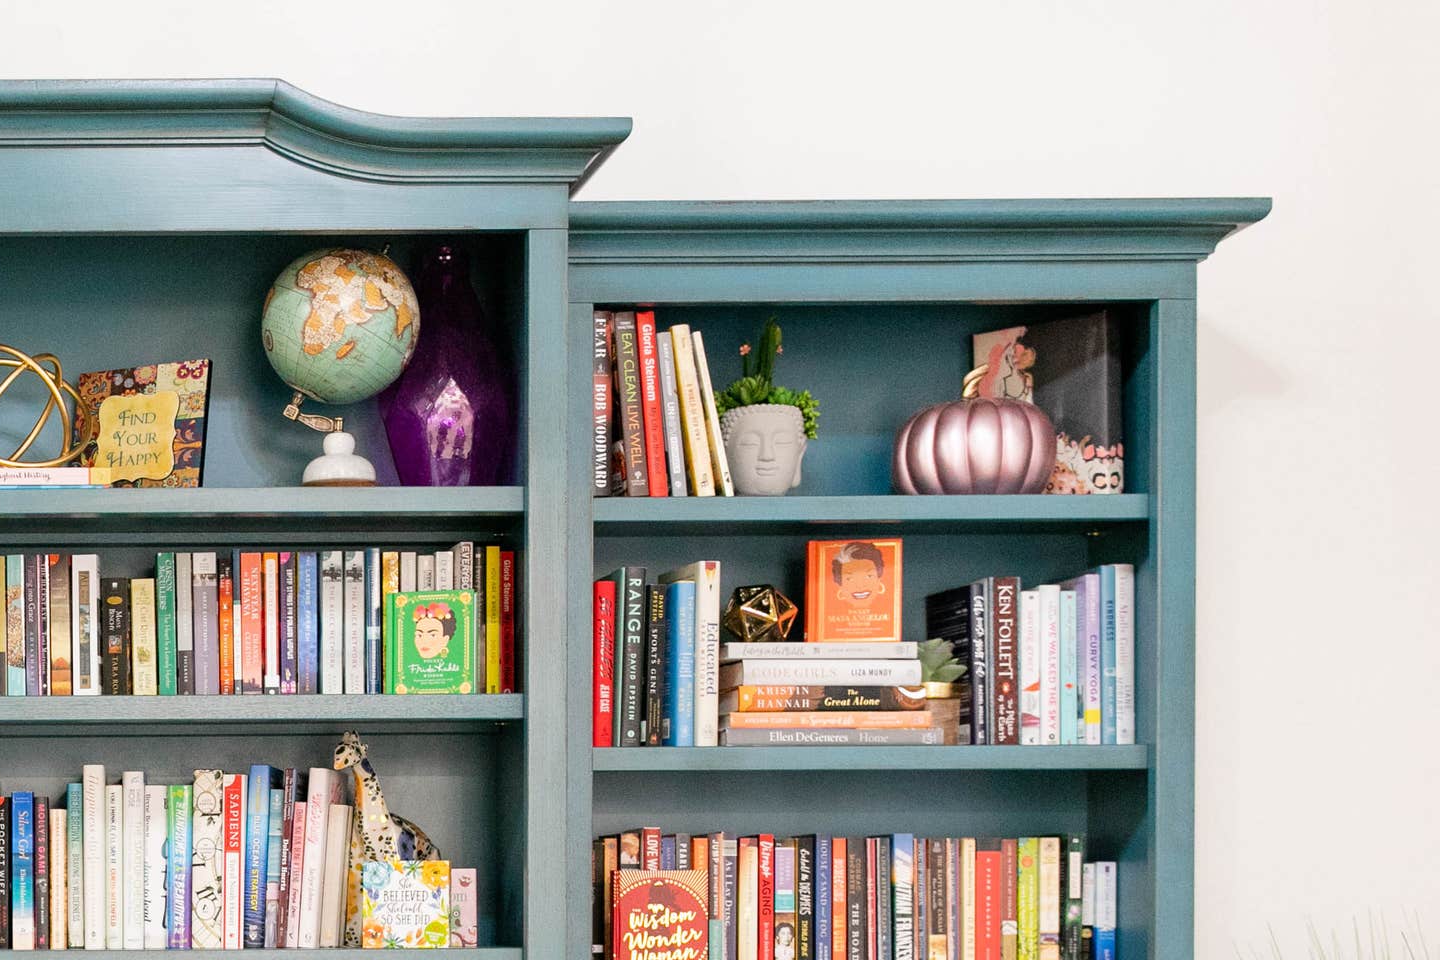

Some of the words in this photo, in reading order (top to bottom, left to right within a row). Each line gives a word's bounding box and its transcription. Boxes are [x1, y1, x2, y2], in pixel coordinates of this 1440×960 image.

[595, 318, 607, 358] FEAR
[621, 332, 634, 355] EAT
[641, 323, 653, 355] Gloria
[623, 360, 637, 402] CLEAN
[644, 358, 656, 401] Steinem
[595, 383, 607, 411] BOB
[118, 409, 157, 427] FIND
[627, 405, 640, 429] LIVE
[112, 430, 159, 447] YOUR
[595, 415, 607, 489] WOODWARD
[628, 431, 642, 468] WELL
[105, 451, 161, 469] HAPPY
[23, 471, 51, 482] History
[503, 559, 511, 581] Gloria
[503, 582, 511, 613] Steinem
[627, 578, 642, 644] RANGE
[997, 585, 1013, 615] KEN
[649, 628, 658, 665] SPORTS
[706, 623, 718, 695] Educated
[998, 619, 1013, 680] FOLLETT
[1088, 634, 1097, 668] CURVY
[628, 653, 637, 680] DAVID
[751, 666, 790, 677] CODE
[794, 666, 837, 677] GIRLS
[851, 669, 866, 677] LIZA
[868, 669, 892, 677] MUNDY
[649, 668, 658, 695] GENE
[756, 686, 810, 696] KRISTIN
[1088, 668, 1097, 703] YOGA
[628, 685, 636, 720] EPSTEIN
[756, 699, 810, 709] HANNAH
[824, 697, 851, 706] Great
[853, 696, 881, 706] Alone
[769, 731, 794, 743] Ellen
[795, 731, 849, 743] DeGeneres
[859, 731, 889, 743] Home
[228, 792, 239, 848] SAPIENS
[382, 890, 429, 903] BELIEVED
[380, 914, 392, 926] SO
[395, 914, 412, 926] SHE
[414, 913, 431, 926] DID
[628, 909, 697, 930] Wisdom
[851, 903, 859, 925] THE
[623, 926, 703, 951] Wonder
